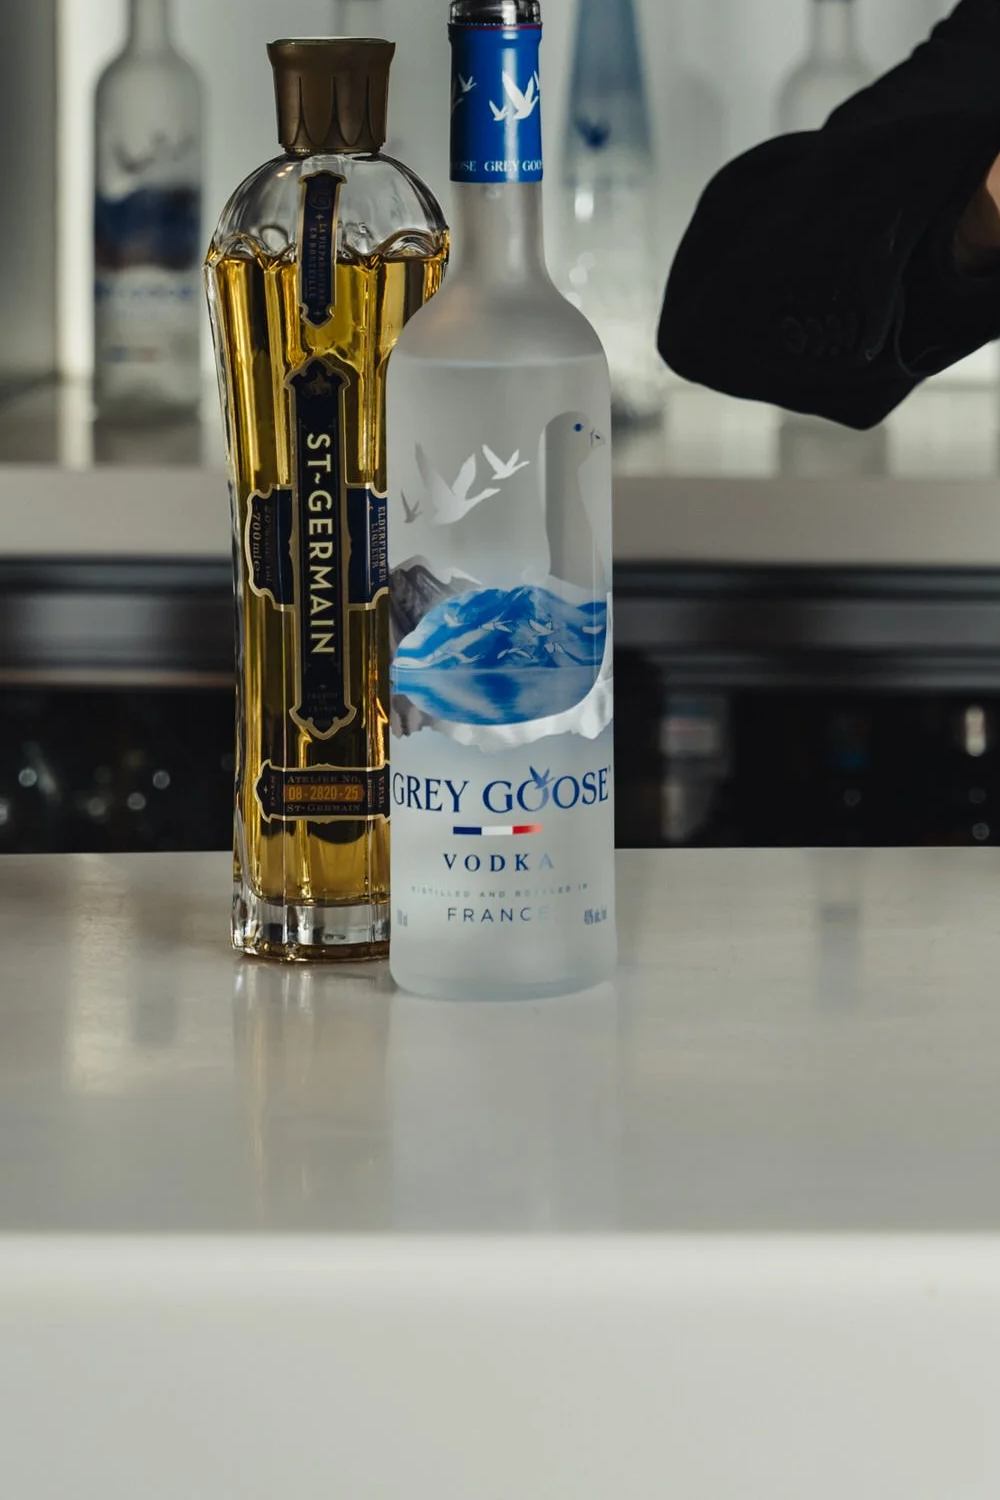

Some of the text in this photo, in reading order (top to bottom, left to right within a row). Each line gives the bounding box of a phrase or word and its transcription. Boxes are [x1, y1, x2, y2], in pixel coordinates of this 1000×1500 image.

[484, 160, 518, 172] GREY
[371, 522, 379, 569] LIQUEUR
[377, 505, 388, 583] ELDERFLOWER
[287, 775, 338, 784] ATELIER
[392, 772, 470, 813] GREY
[482, 766, 609, 813] GOOSE
[443, 852, 555, 873] VODKA
[479, 890, 506, 899] AND
[446, 906, 551, 923] FRANCE
